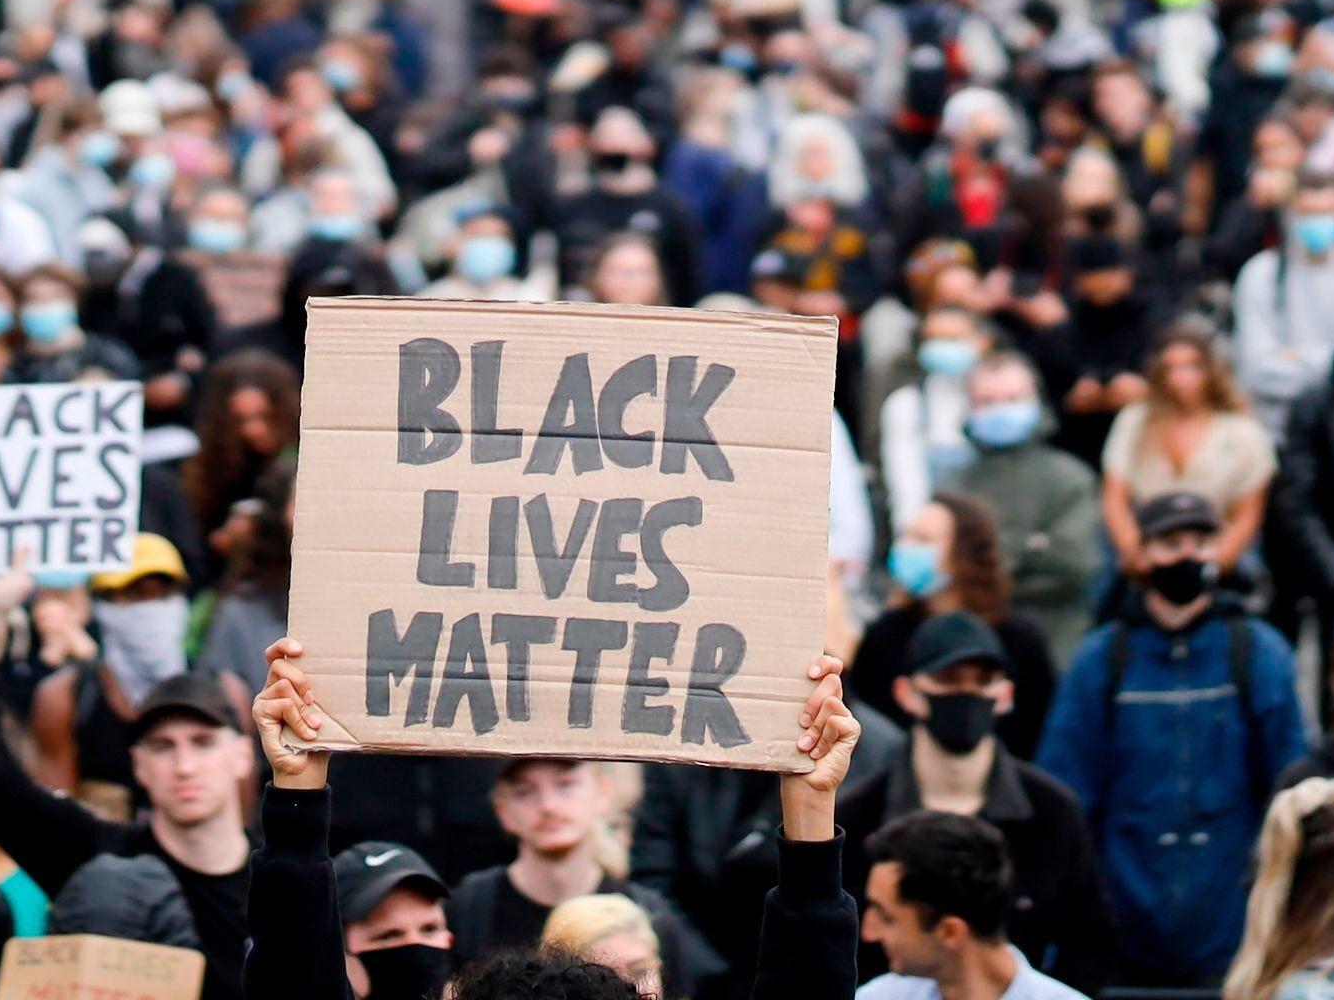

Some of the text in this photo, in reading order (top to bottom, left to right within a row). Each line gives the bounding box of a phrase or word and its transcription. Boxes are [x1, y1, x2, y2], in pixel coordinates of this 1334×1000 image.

[397, 337, 737, 482] BLACK
[416, 489, 704, 613] LIVES
[365, 608, 754, 749] MATTER
